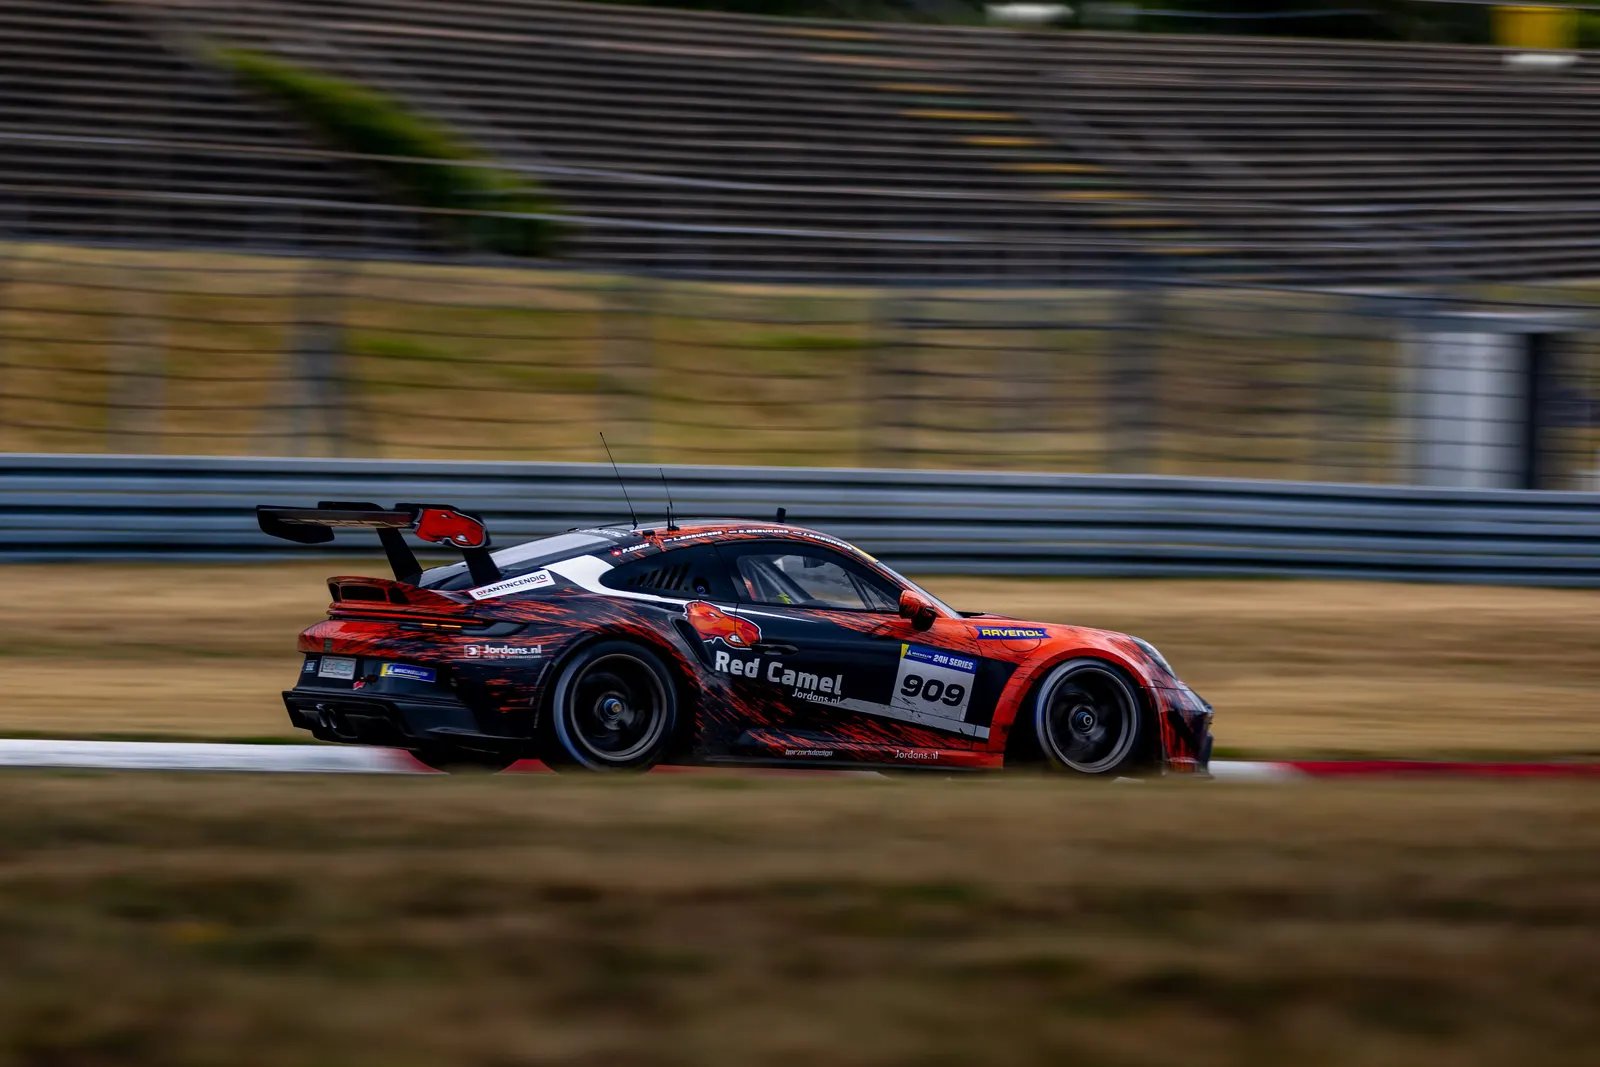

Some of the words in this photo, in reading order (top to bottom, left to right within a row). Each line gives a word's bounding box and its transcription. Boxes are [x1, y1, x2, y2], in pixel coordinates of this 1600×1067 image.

[981, 628, 1043, 637] RAVENOL
[483, 644, 541, 655] Jordans.nl
[933, 654, 949, 665] 24H
[949, 657, 974, 670] SERIES
[715, 650, 760, 678] Red
[767, 661, 843, 695] Camel
[792, 688, 841, 704] Jordans.nl
[900, 674, 965, 706] 909
[894, 750, 939, 759] Jordans.nl
